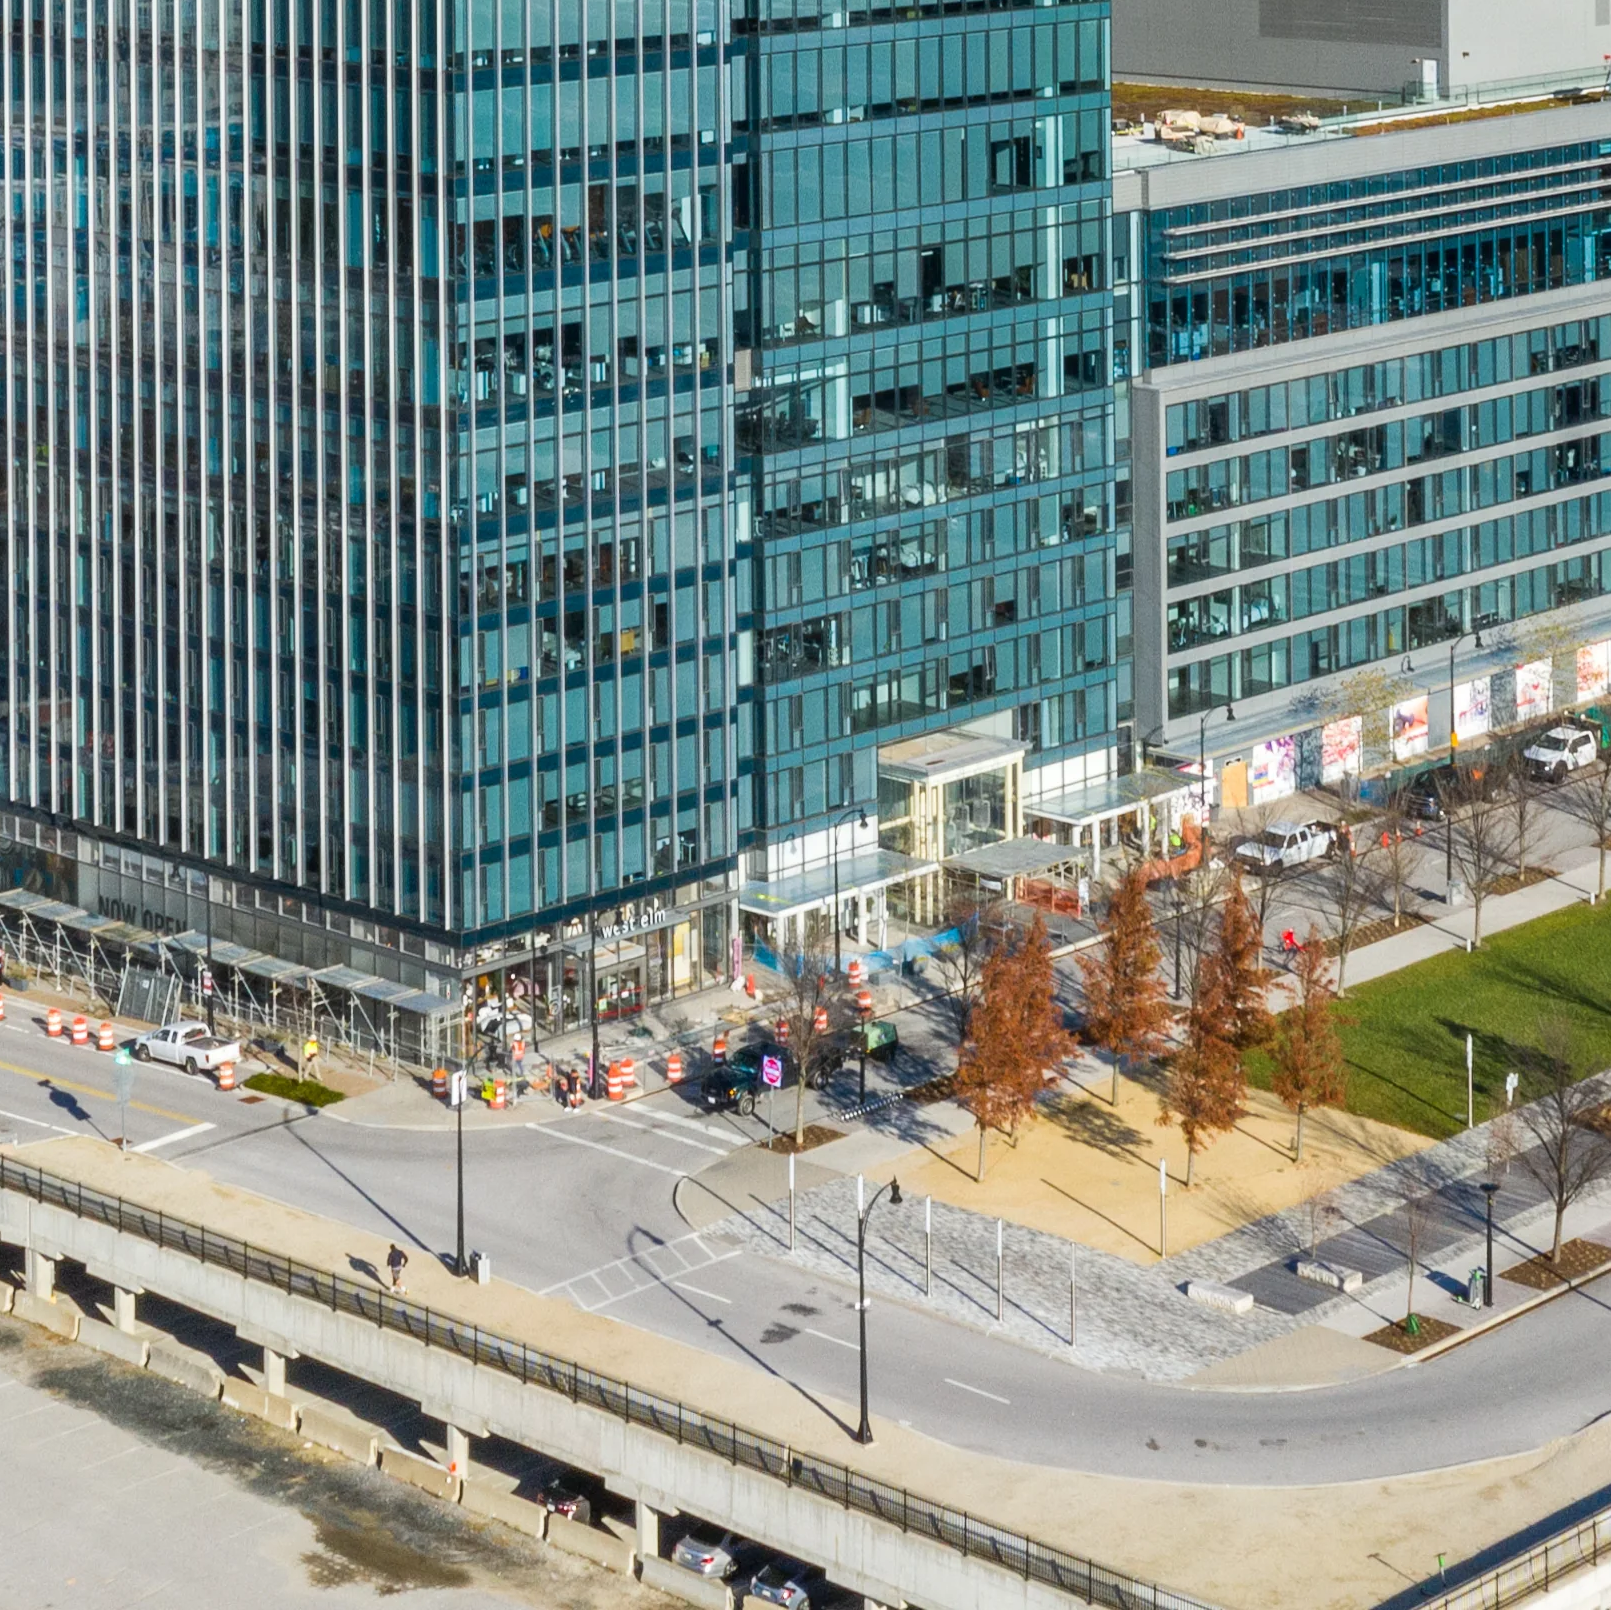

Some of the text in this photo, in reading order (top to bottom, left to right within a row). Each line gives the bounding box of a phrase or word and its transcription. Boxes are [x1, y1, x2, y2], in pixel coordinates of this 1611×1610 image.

[98, 894, 188, 934] NOW OPEN
[602, 909, 666, 939] west elm
